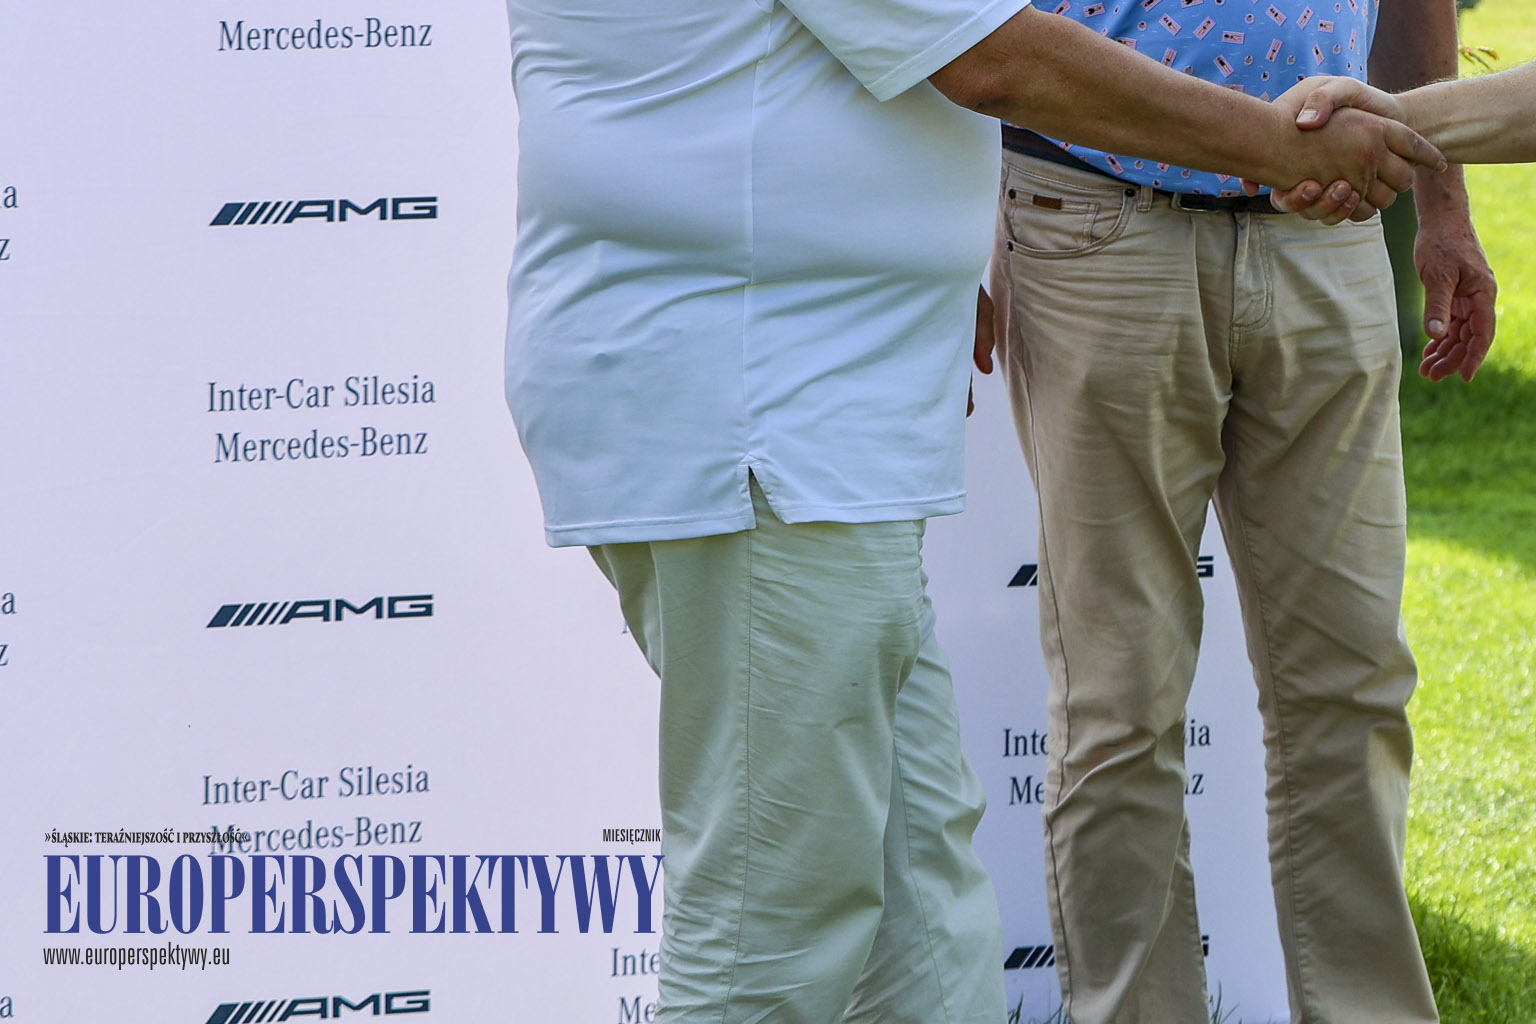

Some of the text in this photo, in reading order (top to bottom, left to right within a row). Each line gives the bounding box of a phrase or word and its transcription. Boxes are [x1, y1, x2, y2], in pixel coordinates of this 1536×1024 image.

[218, 17, 432, 52] Mercedes-Benz
[283, 196, 438, 224] AMG
[208, 374, 435, 412] Inter-Car Silesia
[214, 426, 427, 463] Mercedes-Benz
[279, 594, 434, 625] AMG
[202, 764, 429, 805] Inter-Car Silesia
[279, 989, 431, 1023] AMG
